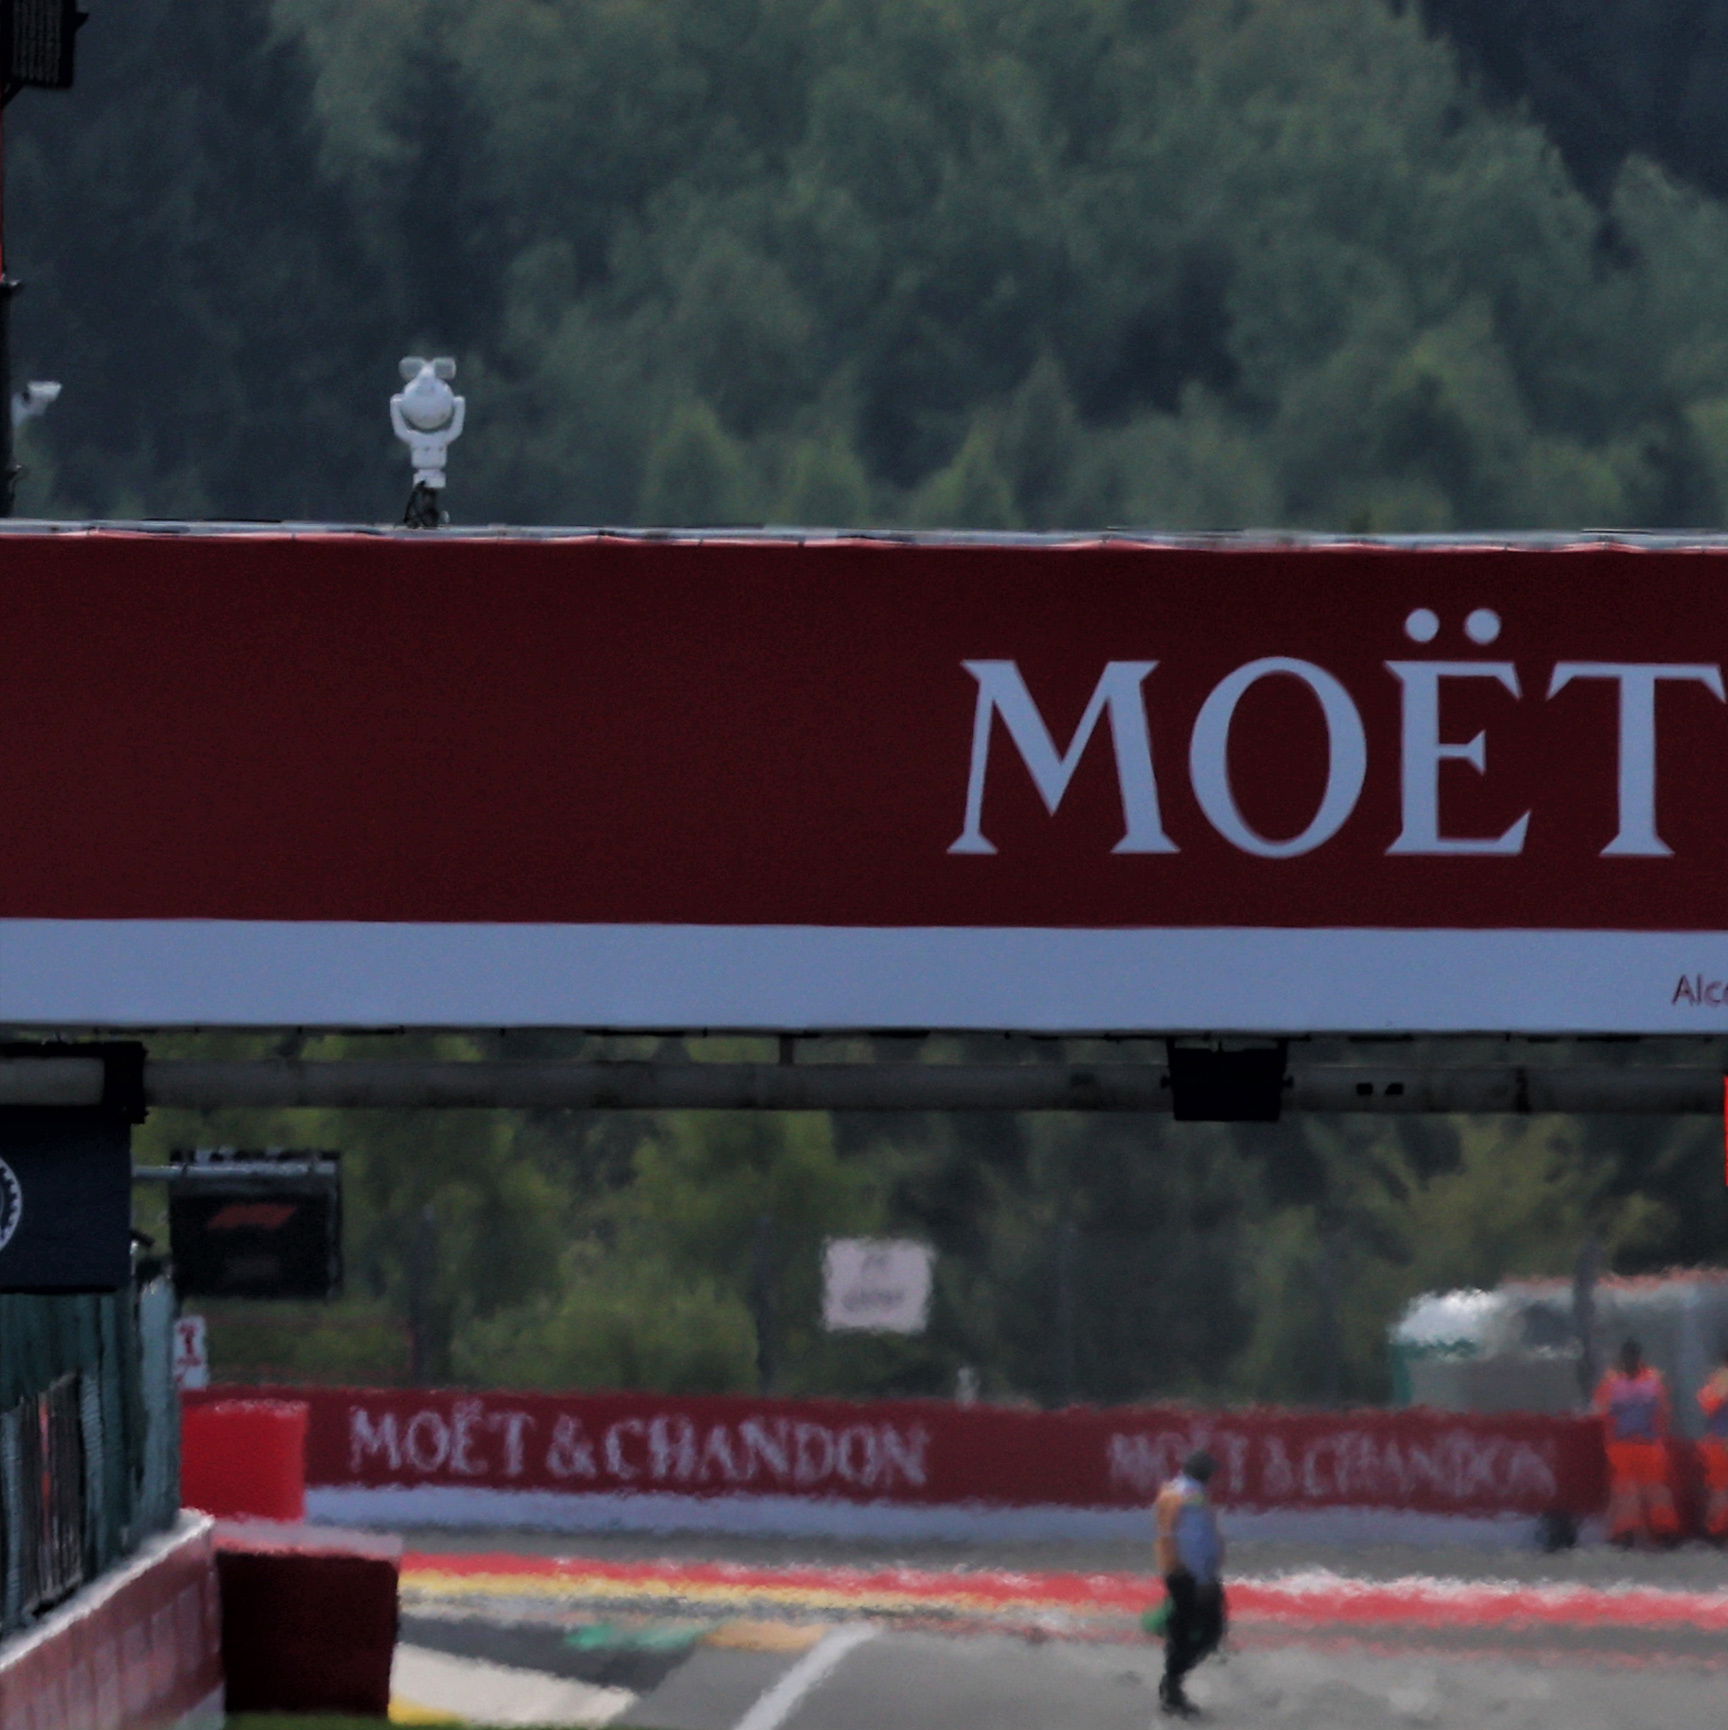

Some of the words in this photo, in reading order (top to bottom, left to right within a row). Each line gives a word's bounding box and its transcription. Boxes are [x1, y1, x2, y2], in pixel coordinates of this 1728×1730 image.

[946, 606, 1728, 858] MOËT
[545, 1412, 598, 1479] &
[605, 1412, 930, 1486] CHANDON
